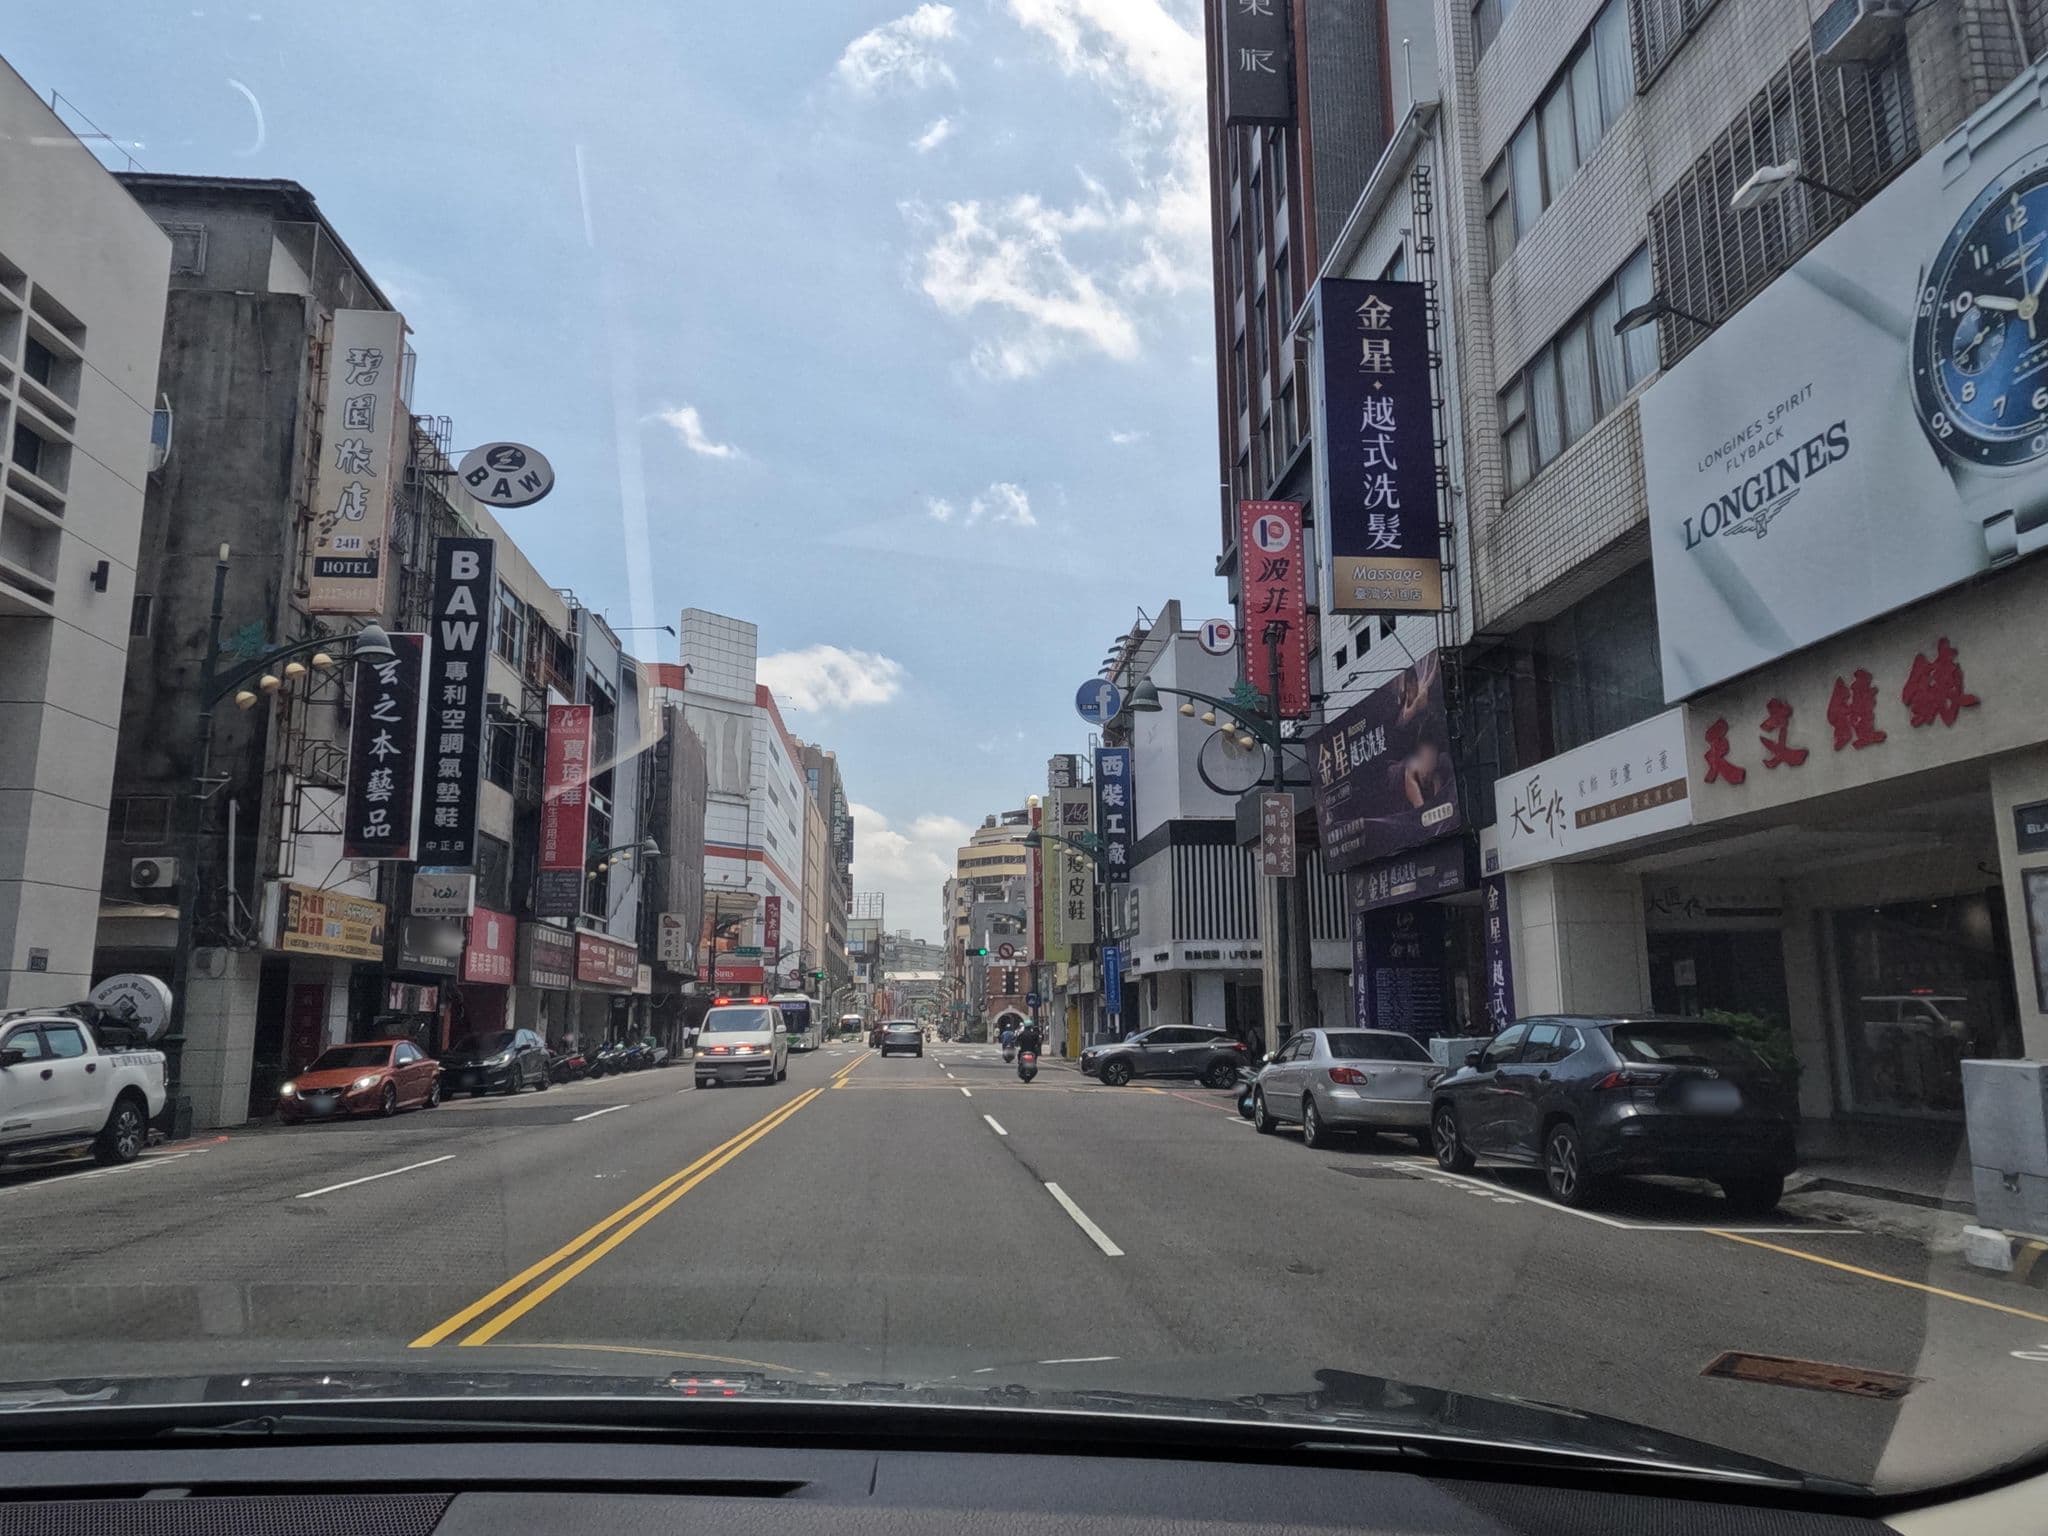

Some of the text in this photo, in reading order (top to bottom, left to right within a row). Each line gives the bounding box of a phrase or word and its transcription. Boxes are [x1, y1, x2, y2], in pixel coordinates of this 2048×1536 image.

[2005, 205, 2028, 234] 12
[1950, 291, 1973, 319] 10
[1961, 381, 1976, 402] 8
[1698, 382, 1813, 473] LONGINES SPIRIT
[1726, 425, 1785, 473] FLYBACK
[465, 465, 542, 499] BAW
[1683, 419, 1850, 552] LONGINES
[335, 537, 360, 549] 24H
[322, 560, 372, 575] HOTEL
[1353, 565, 1423, 583] Massage
[440, 550, 480, 651] BAW
[1318, 730, 1351, 789] 金星
